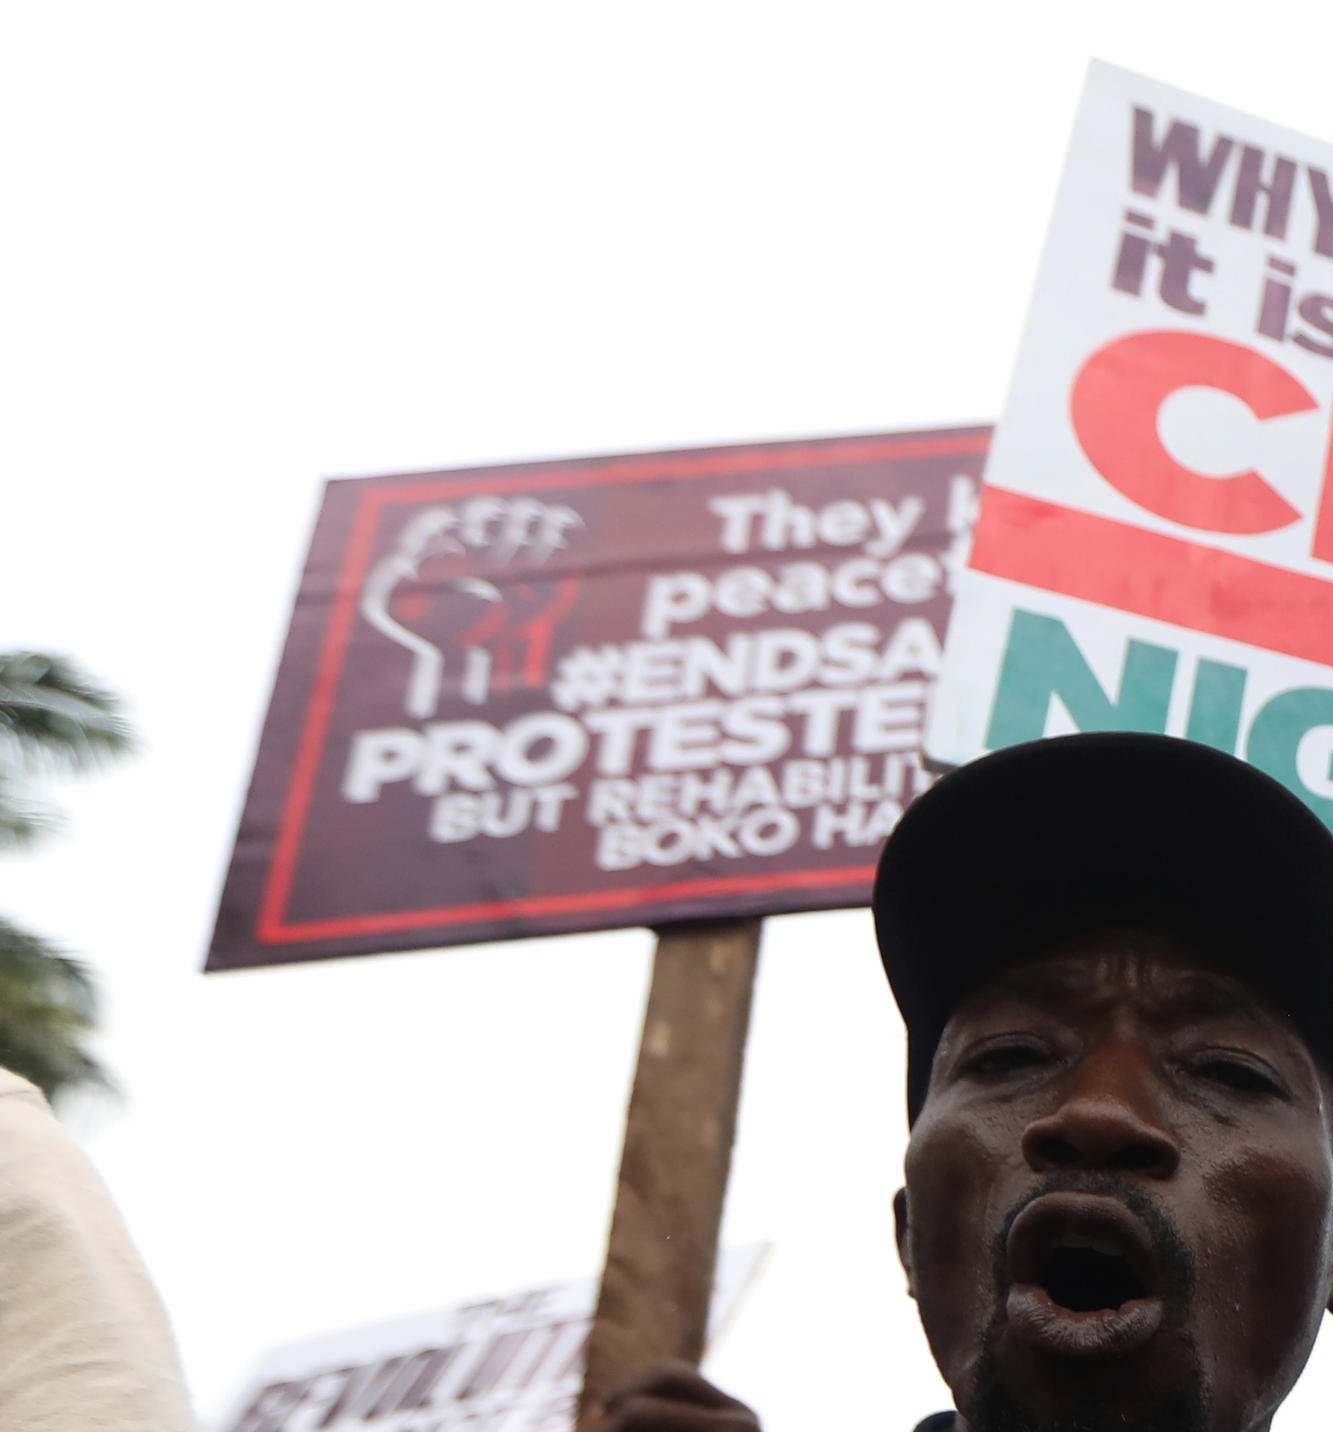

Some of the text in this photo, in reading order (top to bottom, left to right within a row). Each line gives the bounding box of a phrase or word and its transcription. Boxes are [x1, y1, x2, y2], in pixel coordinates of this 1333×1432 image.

[1109, 205, 1216, 318] it
[706, 486, 924, 556] They
[426, 783, 579, 844] BUT
[595, 803, 799, 872] BOKO
